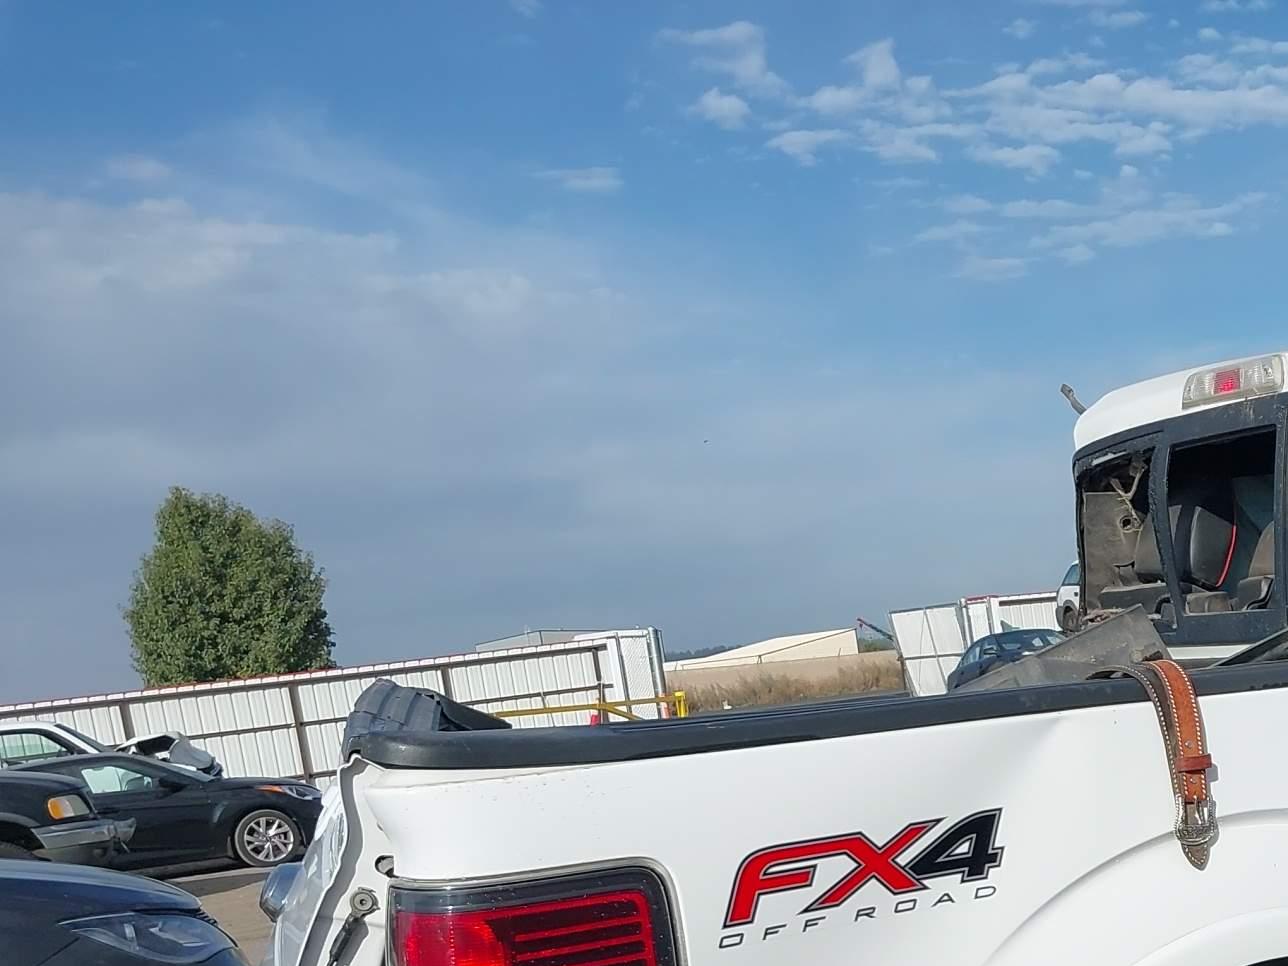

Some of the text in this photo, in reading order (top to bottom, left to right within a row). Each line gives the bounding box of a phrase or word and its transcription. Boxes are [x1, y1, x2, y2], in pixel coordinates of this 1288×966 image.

[722, 807, 1005, 929] FX4
[719, 885, 997, 949] OFF ROAD
